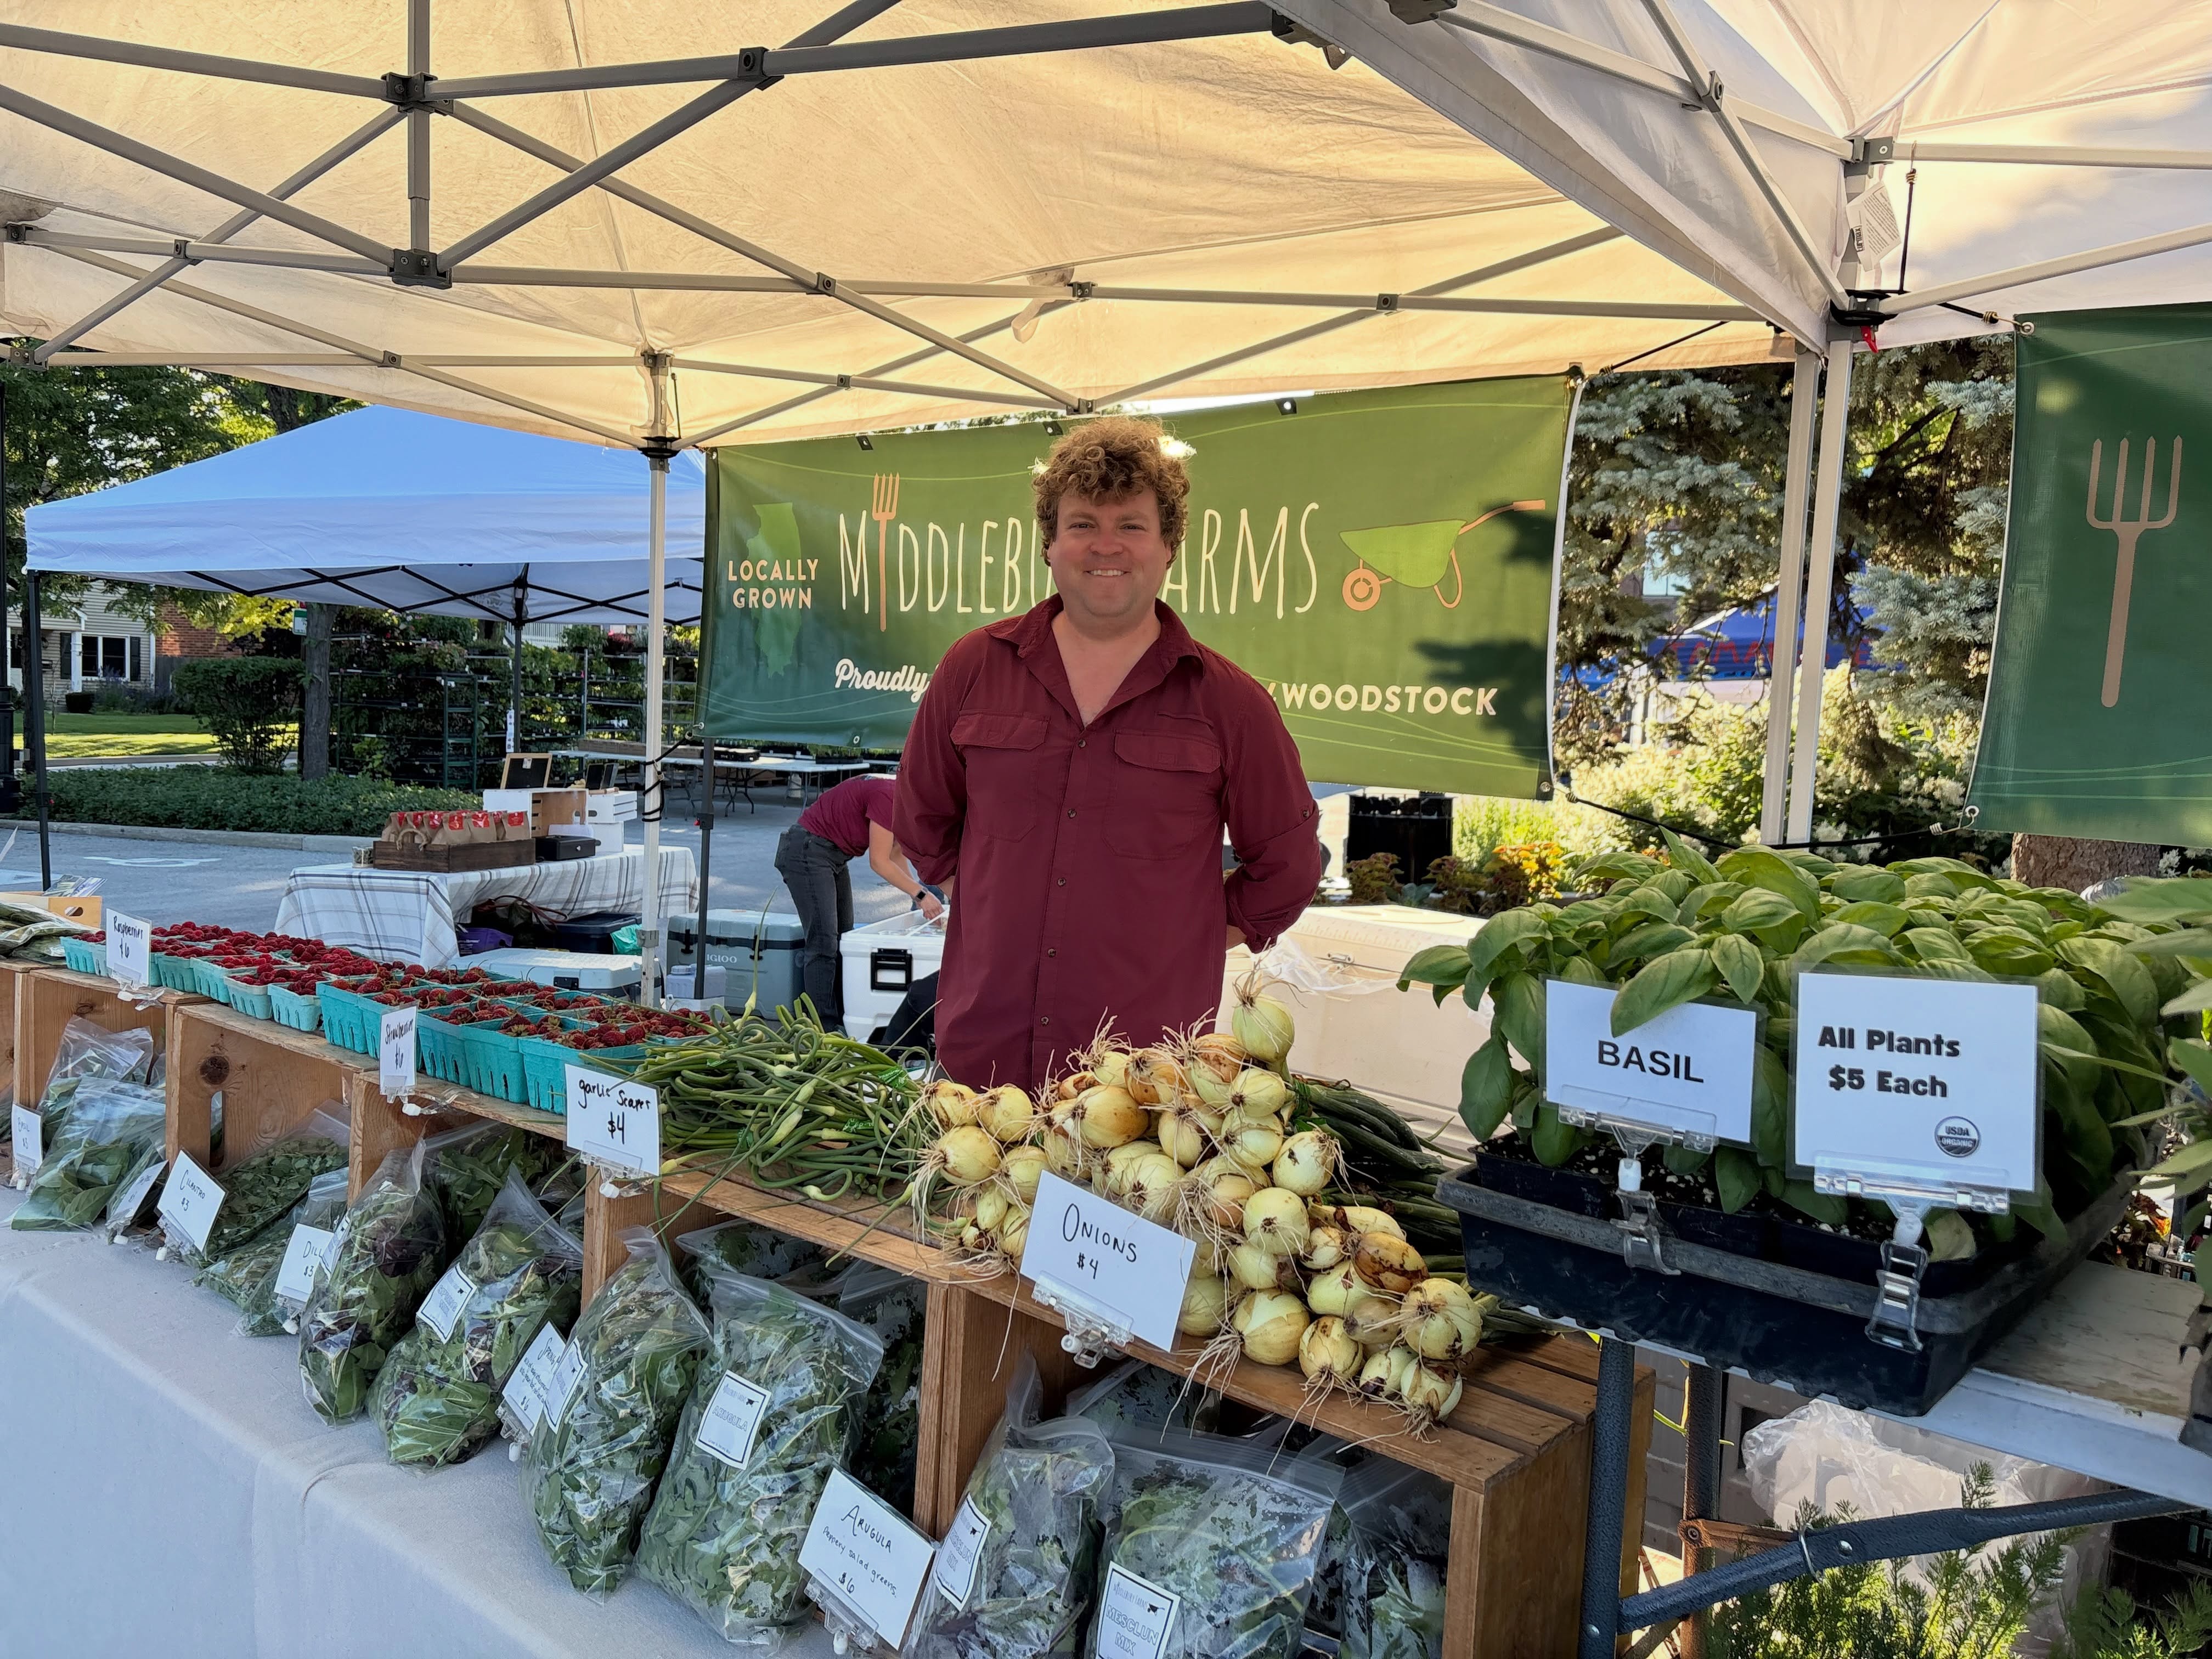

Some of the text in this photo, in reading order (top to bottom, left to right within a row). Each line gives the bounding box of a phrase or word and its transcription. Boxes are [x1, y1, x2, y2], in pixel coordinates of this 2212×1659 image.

[728, 558, 819, 581] LOCALLY
[1161, 501, 1319, 619] ARMS
[732, 587, 812, 610] GROWN
[834, 658, 930, 703] Proudly
[1282, 681, 1498, 716] WOODSTOCK
[120, 938, 129, 959] $6
[1818, 1025, 1961, 1058] All Plants
[396, 1042, 404, 1070] $6
[1597, 1040, 1705, 1084] BASIL
[578, 1079, 610, 1109] garlic
[1828, 1064, 1948, 1098] $5 Each
[607, 1111, 625, 1144] $4
[1945, 1126, 1970, 1136] USDA
[1942, 1138, 1973, 1147] ORGANIC
[179, 1169, 205, 1199] CILANTRO
[181, 1197, 189, 1211] $3
[1063, 1203, 1137, 1262] ONIONS
[303, 1240, 323, 1258] DILL
[303, 1265, 314, 1277] $3
[1077, 1252, 1099, 1279] $4
[521, 1396, 530, 1412] $6
[712, 1405, 748, 1432] ARUGULA
[841, 1505, 892, 1553] ARUGULA
[848, 1549, 869, 1570] salad
[838, 1572, 855, 1594] $6
[1105, 1603, 1159, 1646] MESCLUN
[1114, 1631, 1136, 1657] MIX
